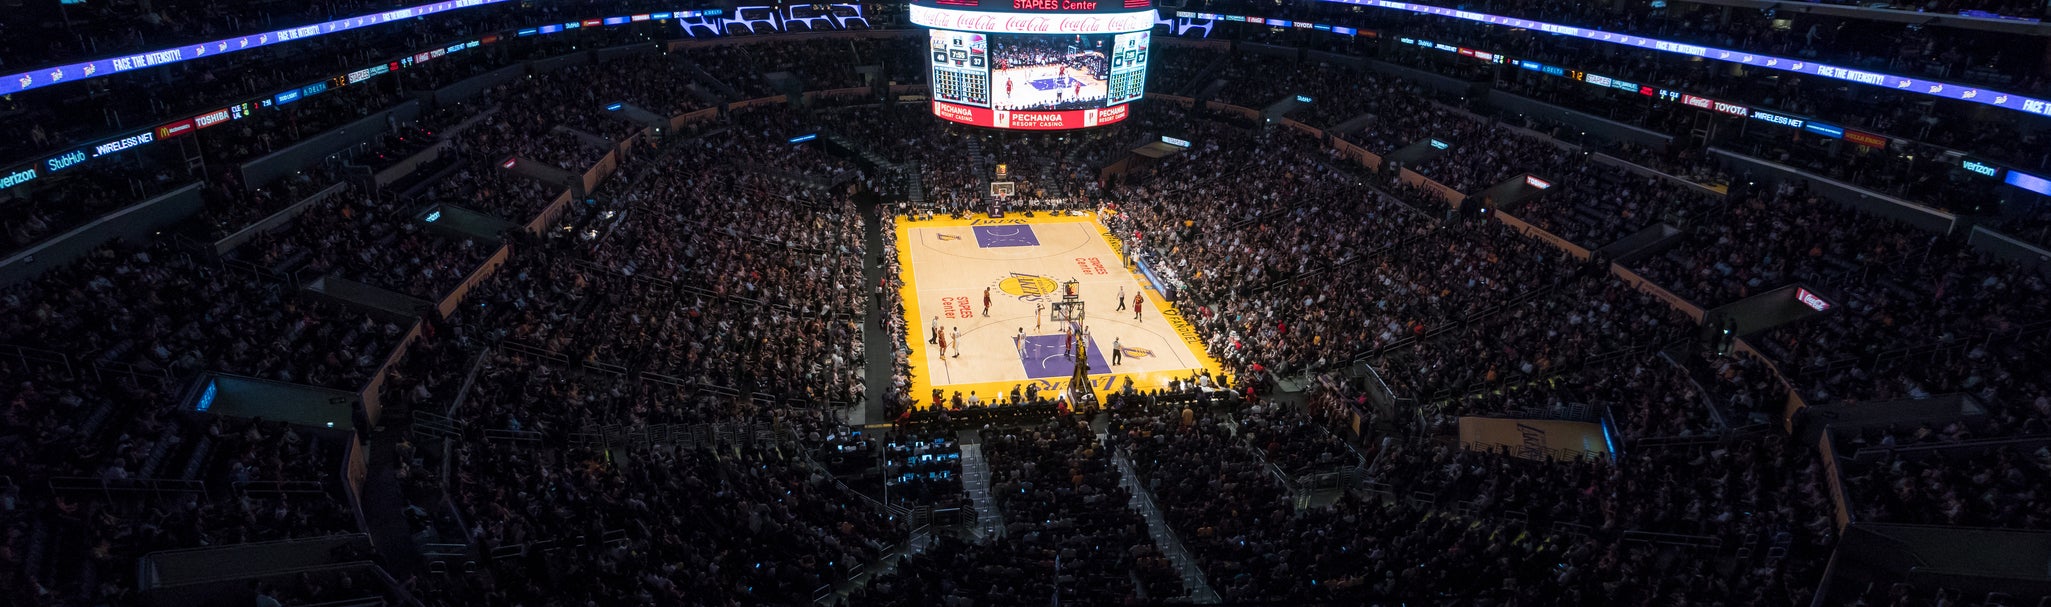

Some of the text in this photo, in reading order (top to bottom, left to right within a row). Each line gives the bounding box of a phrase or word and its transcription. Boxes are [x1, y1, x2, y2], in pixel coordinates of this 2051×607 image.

[1013, 0, 1096, 10] STAPLES Center
[113, 57, 131, 71] FACE
[131, 53, 147, 68] THE
[146, 49, 182, 66] INTENSITY!
[1817, 65, 1834, 78] FACE
[1833, 67, 1848, 80] THE
[1847, 70, 1885, 86] INTENSITY!
[308, 83, 327, 94] DELTA
[941, 103, 973, 116] PECHANGA
[1714, 102, 1747, 116] TOYOTA
[2022, 99, 2044, 113] FACE
[195, 110, 230, 127] TOSHIBA
[1012, 113, 1062, 122] PECHANGA
[1788, 119, 1803, 128] NET
[138, 132, 154, 145] NET
[48, 150, 86, 171] StubHub
[1963, 160, 1995, 176] verizon
[1009, 271, 1044, 302] LAKERS
[942, 297, 956, 319] Center
[957, 296, 973, 319] STAPLES
